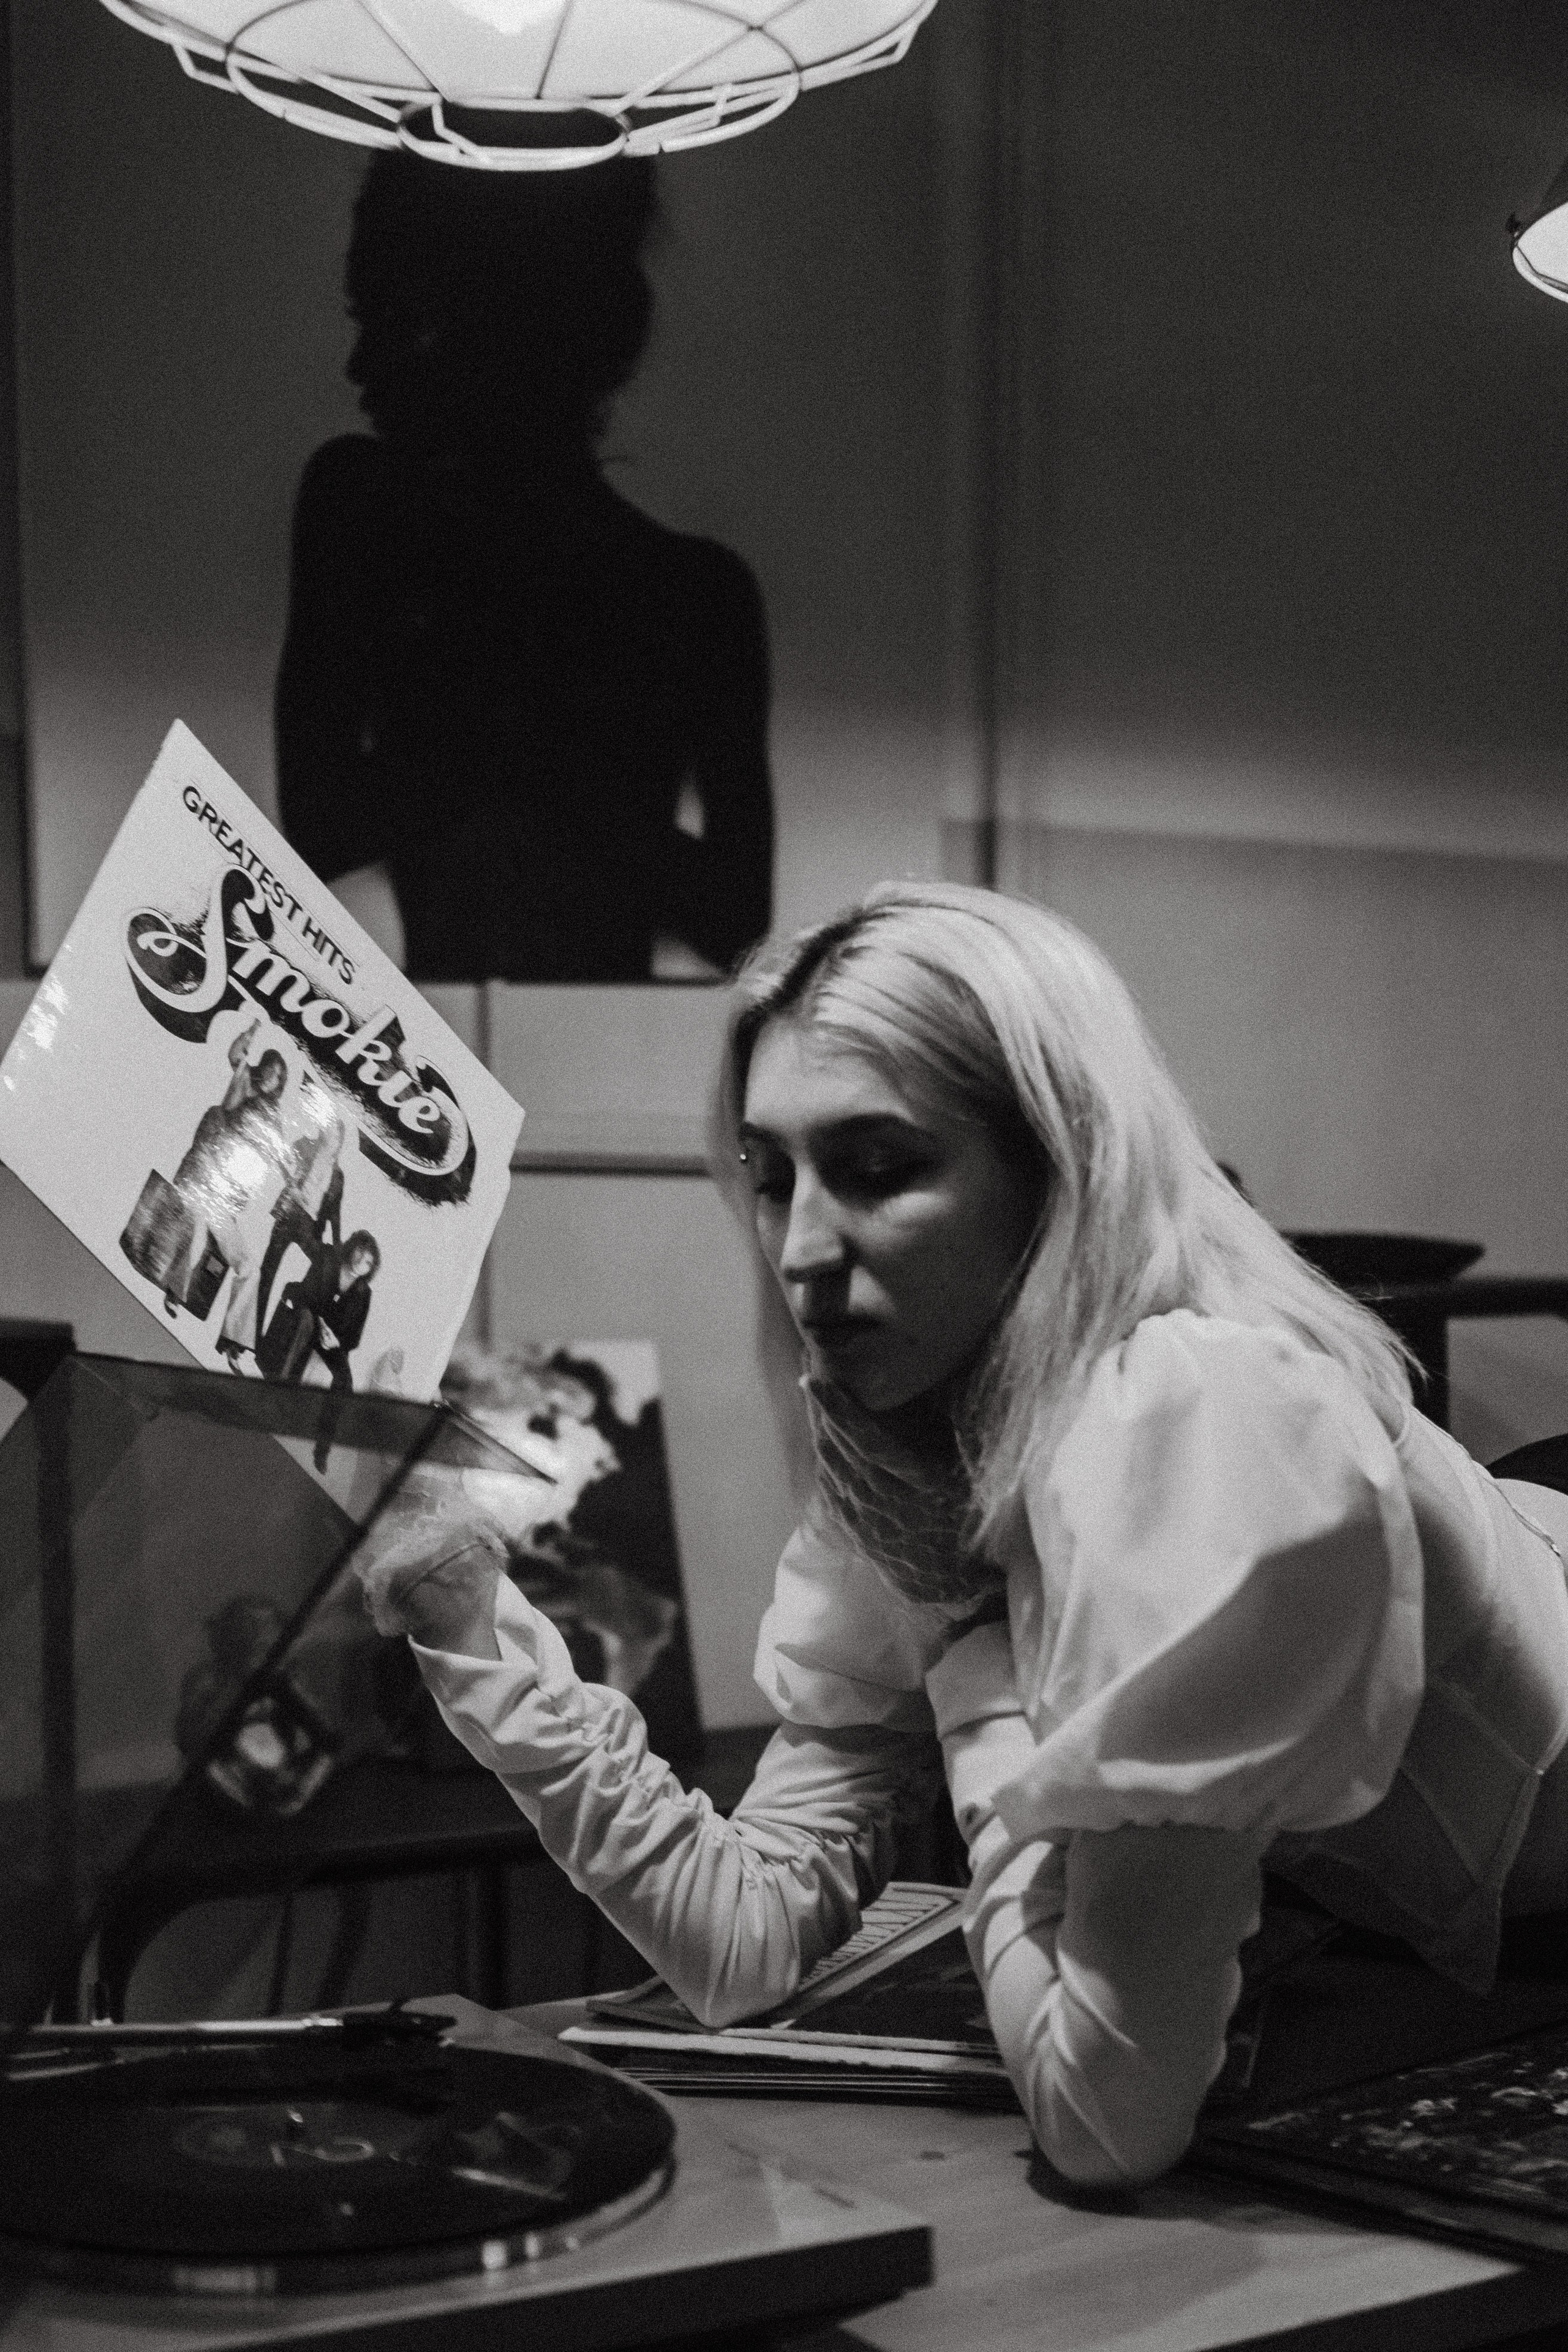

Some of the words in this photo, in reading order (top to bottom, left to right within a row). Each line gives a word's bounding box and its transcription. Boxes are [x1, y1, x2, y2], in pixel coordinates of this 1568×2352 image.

[182, 785, 304, 921] GREATEST
[302, 916, 356, 985] HITS
[125, 864, 473, 1182] Smokie
